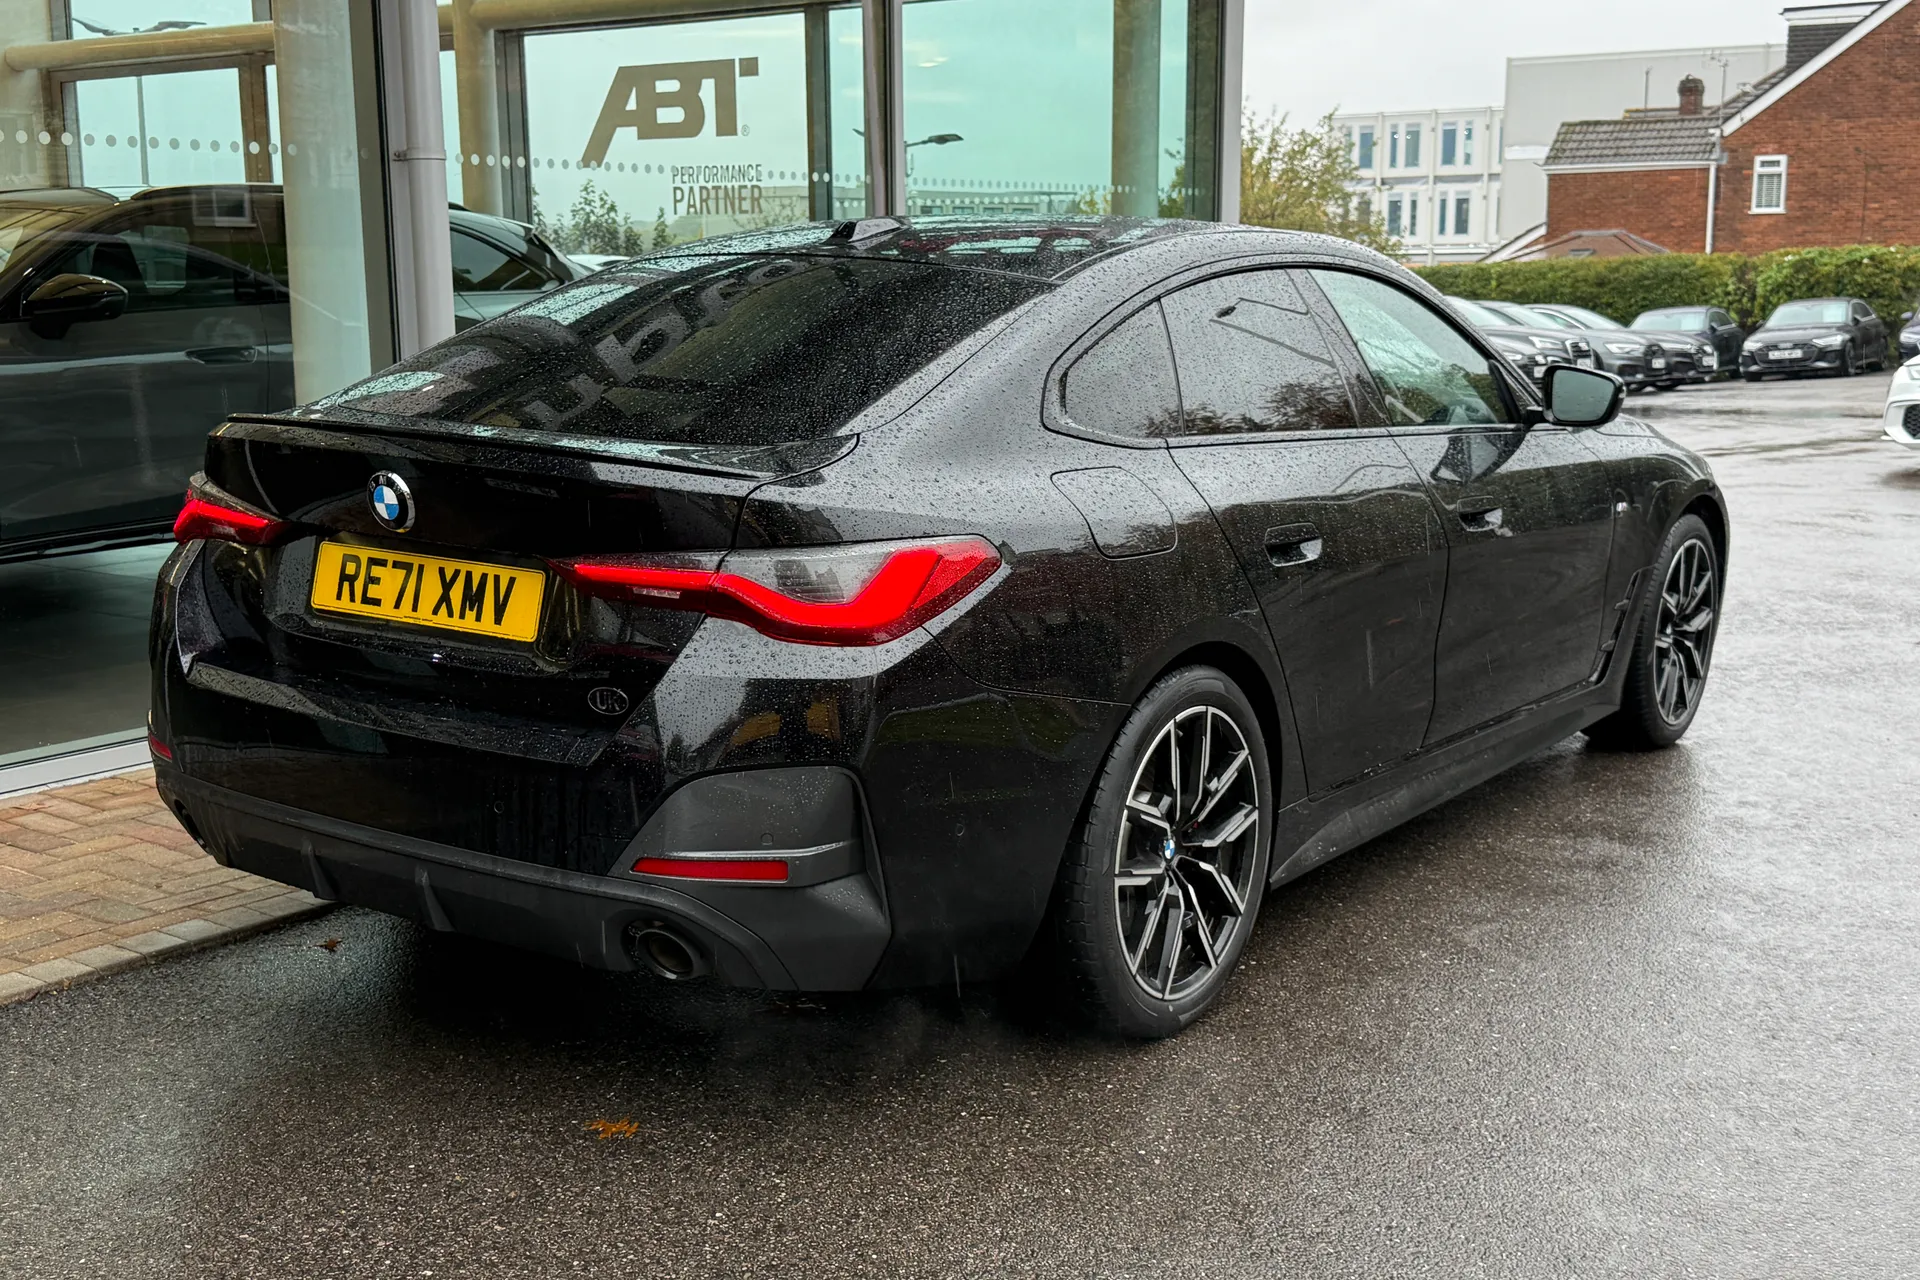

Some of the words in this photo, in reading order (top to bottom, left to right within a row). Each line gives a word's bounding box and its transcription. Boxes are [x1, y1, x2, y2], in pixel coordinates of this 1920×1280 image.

[580, 57, 758, 168] ABT
[672, 164, 763, 184] PERFORMANCE
[673, 185, 763, 215] PARTNER
[335, 553, 425, 613] RE71
[431, 566, 516, 627] XMV
[596, 691, 620, 711] UK
